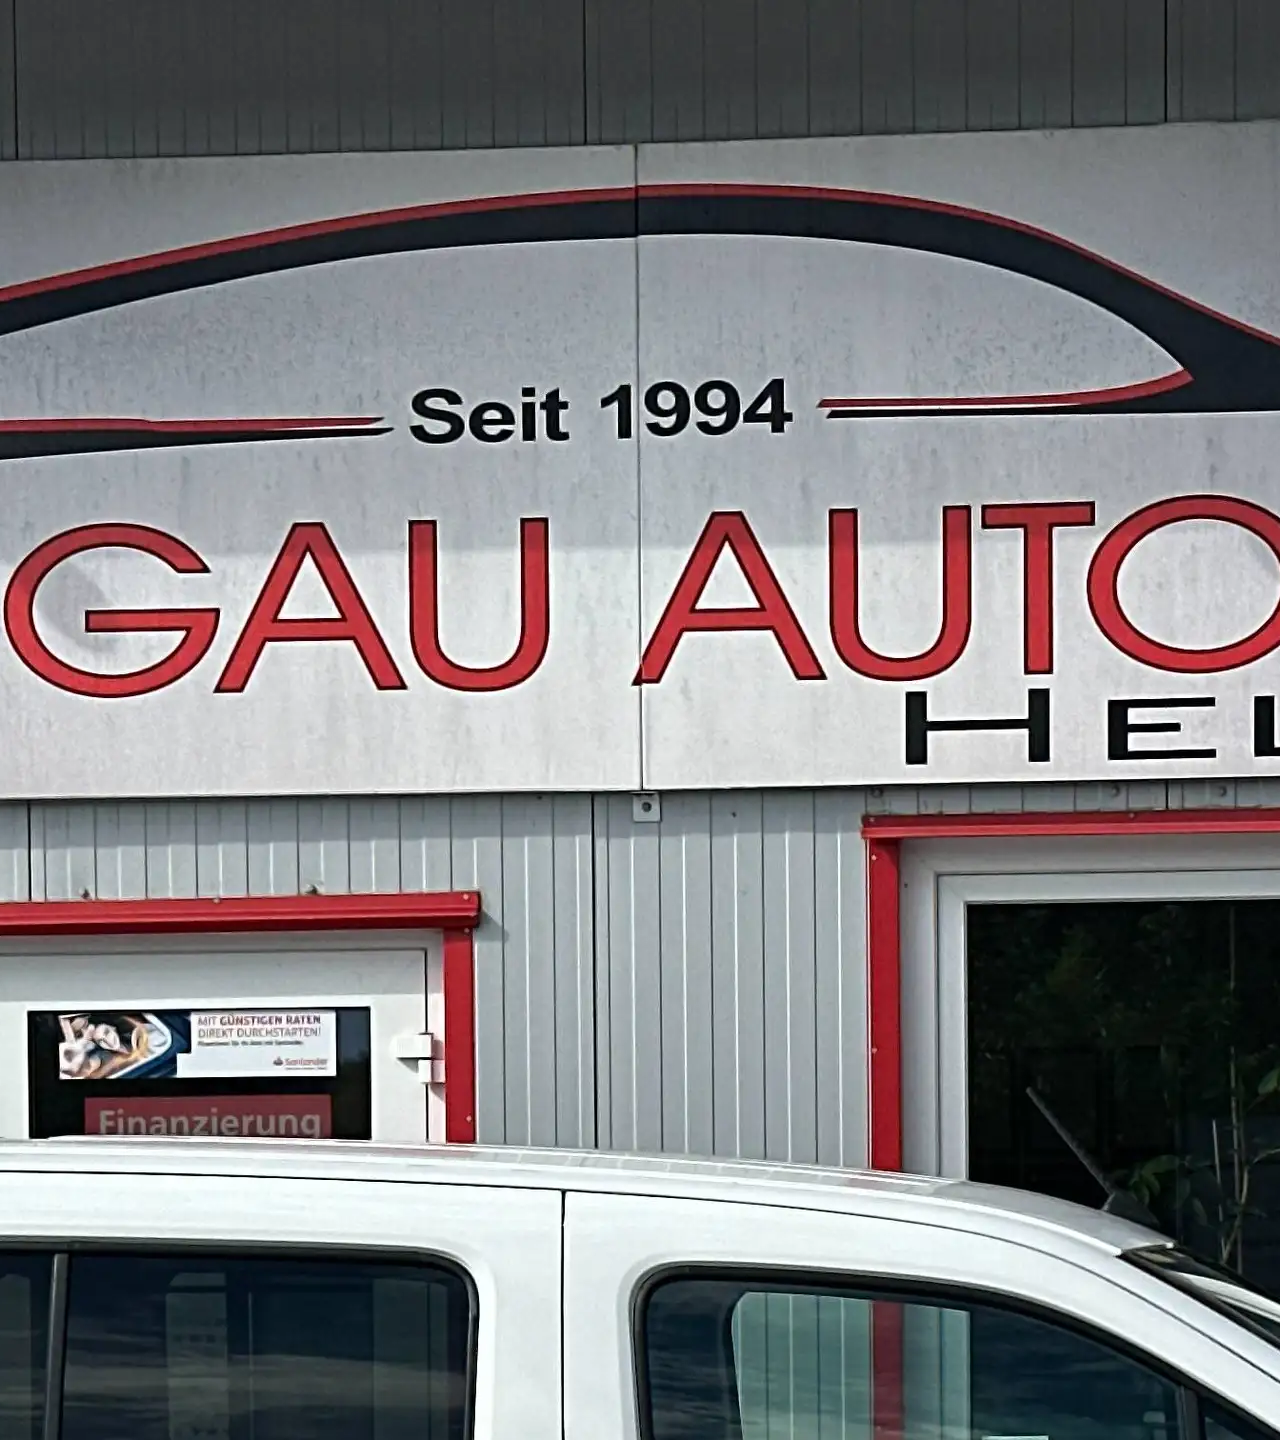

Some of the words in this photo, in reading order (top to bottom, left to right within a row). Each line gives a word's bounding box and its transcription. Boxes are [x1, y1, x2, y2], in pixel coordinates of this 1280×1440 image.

[409, 387, 570, 444] Seit
[600, 378, 794, 439] 1994
[197, 1015, 217, 1026] MIT
[219, 1013, 283, 1026] GÜNSTIGEN
[285, 1014, 321, 1025] RATEN
[197, 1027, 235, 1038] DIREKT
[236, 1026, 321, 1038] DURCHSTARTEN!
[98, 1107, 322, 1138] Finanzierung
